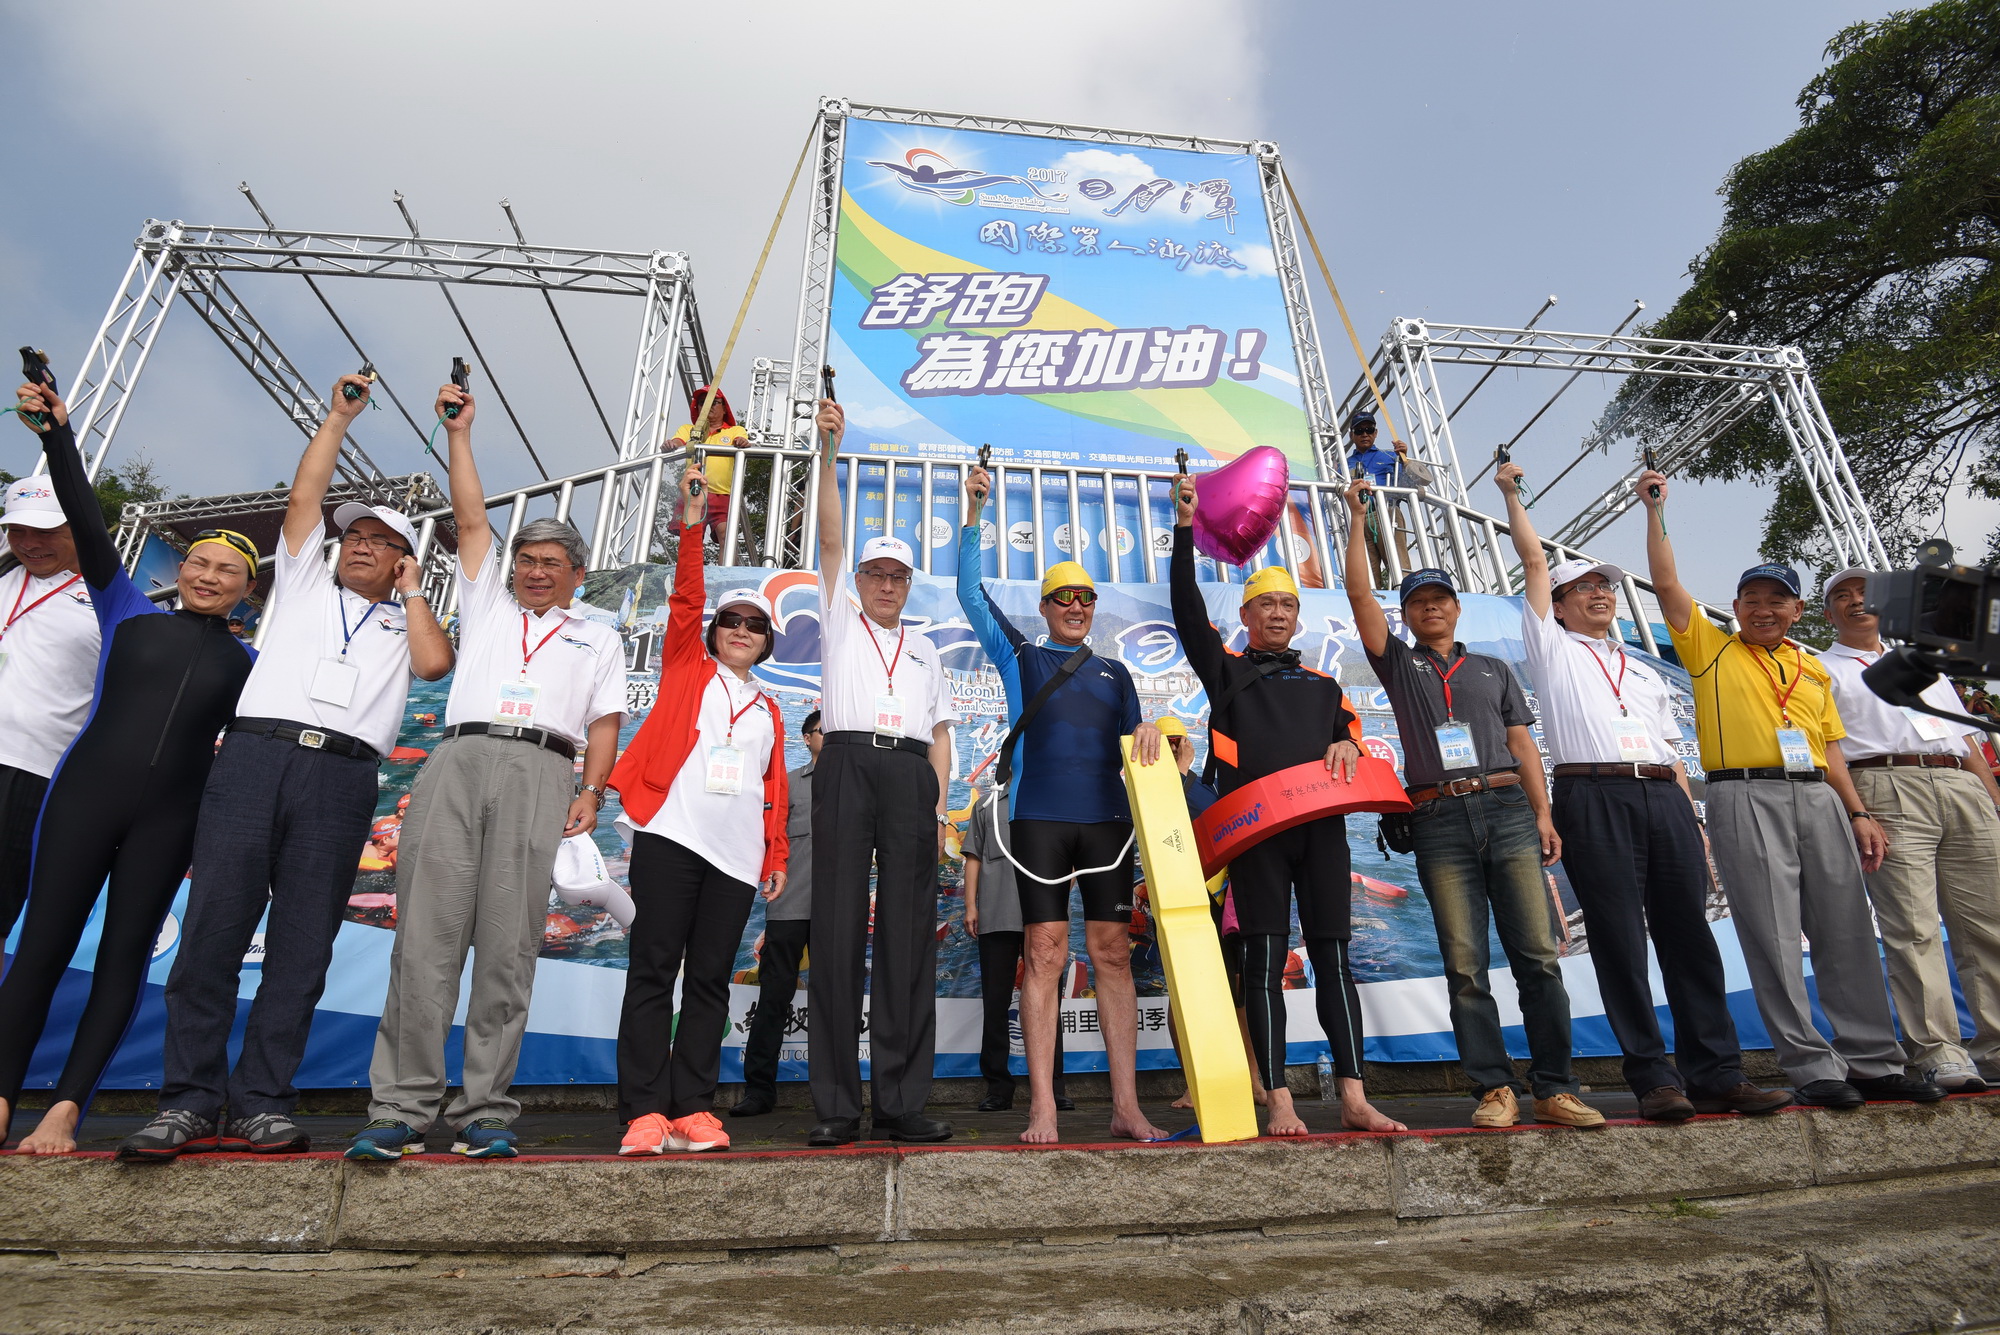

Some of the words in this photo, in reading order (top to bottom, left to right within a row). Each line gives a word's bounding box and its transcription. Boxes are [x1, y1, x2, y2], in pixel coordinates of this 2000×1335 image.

[1028, 167, 1067, 183] 2017
[980, 193, 997, 201] Sun
[998, 195, 1022, 204] Moon
[1025, 197, 1044, 205] Lake
[1077, 179, 1237, 234] 日月潭
[980, 219, 1247, 270] 國際萬人泳渡
[862, 273, 1045, 327] 舒跑
[950, 682, 990, 697] Moon
[500, 701, 533, 716] 貴賓
[1213, 806, 1262, 843] Marium
